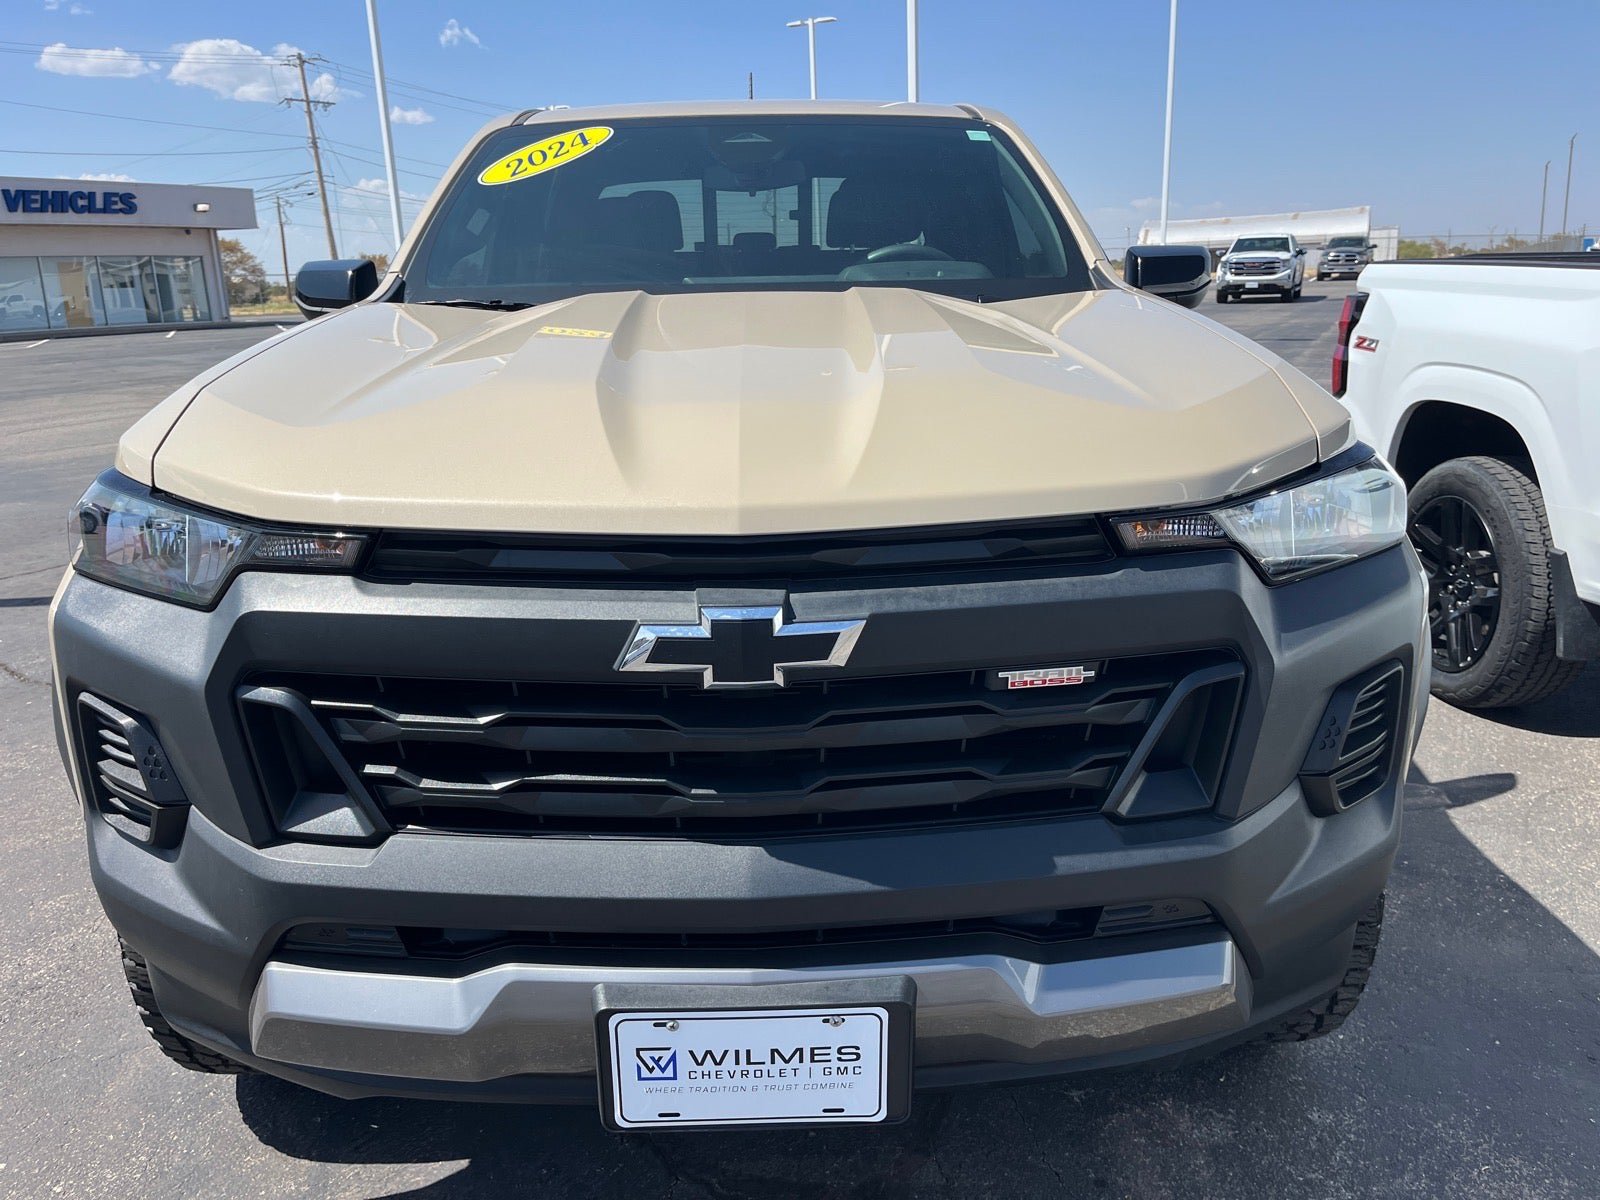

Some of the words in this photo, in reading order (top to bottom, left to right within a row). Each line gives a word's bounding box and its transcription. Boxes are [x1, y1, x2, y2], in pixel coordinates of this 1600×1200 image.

[506, 132, 591, 177] 2024
[1, 189, 138, 215] VEHICLES
[998, 666, 1095, 681] TRAIL
[1009, 676, 1082, 688] BOSS
[688, 1045, 861, 1066] WILMES
[688, 1067, 800, 1080] CHEVROLET
[823, 1065, 862, 1077] GMC
[645, 1086, 684, 1094] WHERE
[689, 1085, 747, 1093] TRADITION
[764, 1083, 799, 1092] TRUST
[803, 1081, 854, 1091] COMBINE
